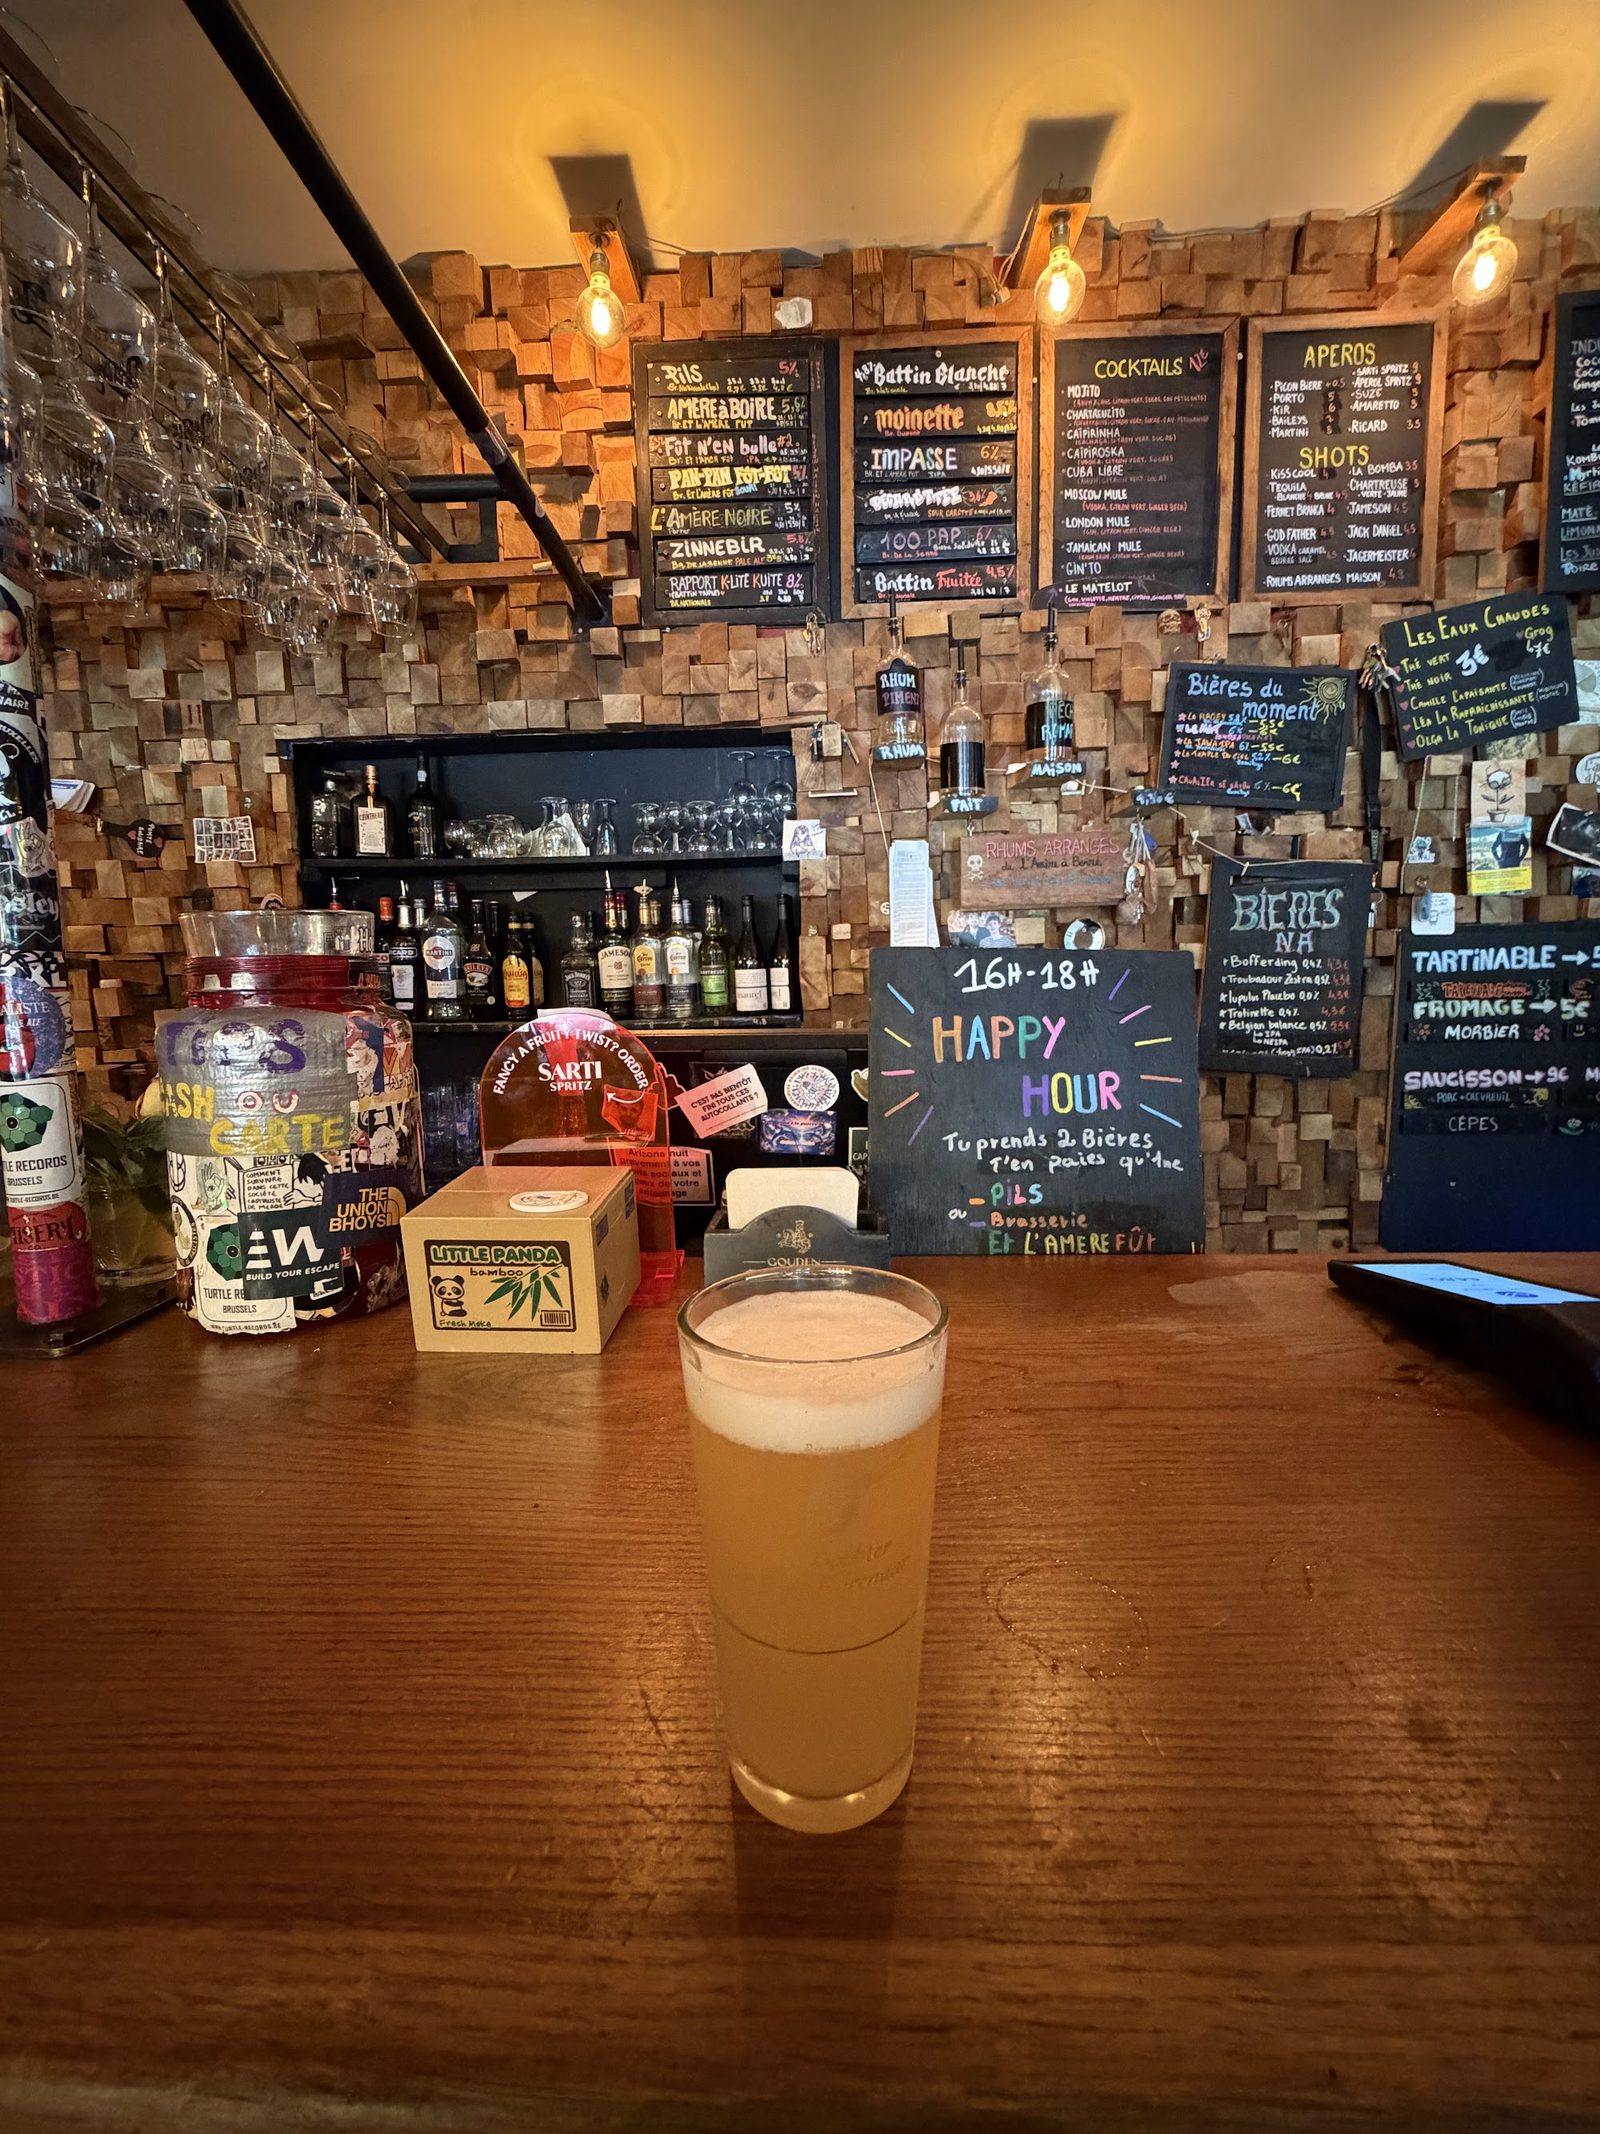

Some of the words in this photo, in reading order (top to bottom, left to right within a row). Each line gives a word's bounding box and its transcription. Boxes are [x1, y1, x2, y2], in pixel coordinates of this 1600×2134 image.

[1303, 342, 1376, 369] APEROS
[874, 362, 931, 386] Battin
[935, 361, 1009, 385] Blanche
[1095, 356, 1183, 379] COCKTAILS
[1354, 376, 1382, 388] APEROL
[1273, 393, 1305, 404] PORTO
[1353, 400, 1400, 412] AMARETTO
[875, 403, 964, 433] moinette
[740, 435, 777, 455] bulle
[1300, 445, 1369, 469] SHOTS
[1067, 466, 1093, 478] CUBA
[1352, 467, 1362, 476] LA
[1368, 461, 1403, 475] BOMBA
[1350, 478, 1408, 491] CHARTREUSE
[1064, 489, 1102, 501] MOSCOW
[1104, 488, 1127, 500] MULE
[1349, 502, 1391, 515] JAMESON
[1065, 517, 1103, 528] LONDON
[1106, 516, 1130, 528] MULE
[881, 531, 921, 550] 100
[928, 527, 961, 546] PAP
[1267, 529, 1284, 542] GOD
[1287, 528, 1316, 541] FATHER
[1347, 525, 1370, 539] JACK
[1118, 540, 1142, 552] MULE
[1267, 544, 1296, 555] VODKA
[670, 575, 718, 590] RAPPORT
[936, 569, 983, 590] Fruitée
[1065, 584, 1077, 594] LE
[1083, 581, 1133, 594] MATELOT
[1403, 621, 1436, 648] LES
[1438, 615, 1479, 640] EAUX
[1483, 603, 1550, 630] CHAUDES
[1524, 626, 1553, 642] Grog
[1427, 651, 1451, 667] VERT
[1455, 643, 1489, 677] 3€
[880, 672, 917, 689] RHUM
[1260, 678, 1283, 698] du
[1242, 700, 1319, 721] moment
[1416, 733, 1443, 748] OLGA
[1446, 726, 1459, 740] LA
[880, 744, 925, 759] RHUM
[986, 840, 1037, 859] RHUMS
[1230, 954, 1299, 973] Bofferding
[1227, 975, 1283, 985] Troubadour
[1412, 999, 1525, 1020] FROMAGE
[1560, 999, 1590, 1021] 5€
[1228, 1019, 1265, 1034] Belgian
[1268, 1020, 1308, 1030] balance
[932, 1015, 1066, 1064] HAPPY
[493, 1053, 521, 1095] FANCY
[518, 1046, 530, 1058] A
[526, 1029, 572, 1050] FRUITY
[575, 1029, 620, 1053] TWIST?
[617, 1048, 650, 1090] ORDER
[538, 1061, 602, 1082] SARTI
[1547, 1066, 1569, 1083] 9€
[550, 1081, 593, 1092] SPRITZ
[1021, 1070, 1123, 1118] HOUR
[235, 1088, 299, 1114] OU
[702, 1103, 716, 1112] FINI
[717, 1094, 735, 1105] TOUS
[736, 1088, 749, 1097] CES
[712, 1091, 723, 1100] PAS
[942, 1131, 971, 1152] Tu
[976, 1128, 1049, 1160] prends
[1057, 1129, 1076, 1148] 2
[1081, 1126, 1154, 1149] Bières
[16, 1155, 67, 1172] RECORDS
[1049, 1152, 1106, 1174] paies
[692, 1169, 702, 1177] et
[359, 1187, 388, 1203] THE
[336, 1200, 388, 1220] UNION
[948, 1207, 967, 1220] ou
[328, 1214, 388, 1233] BHOYS
[990, 1211, 1088, 1229] Brasserie
[431, 1245, 490, 1263] LITTLE
[492, 1245, 563, 1264] PANDA
[245, 1272, 273, 1282] BUILD
[275, 1269, 303, 1280] YOUR
[305, 1262, 341, 1277] ESCAPE
[469, 1268, 524, 1277] bamboo
[203, 1287, 232, 1299] TURTLE
[222, 1305, 257, 1314] BRUSSELS
[439, 1319, 466, 1328] Fresh
